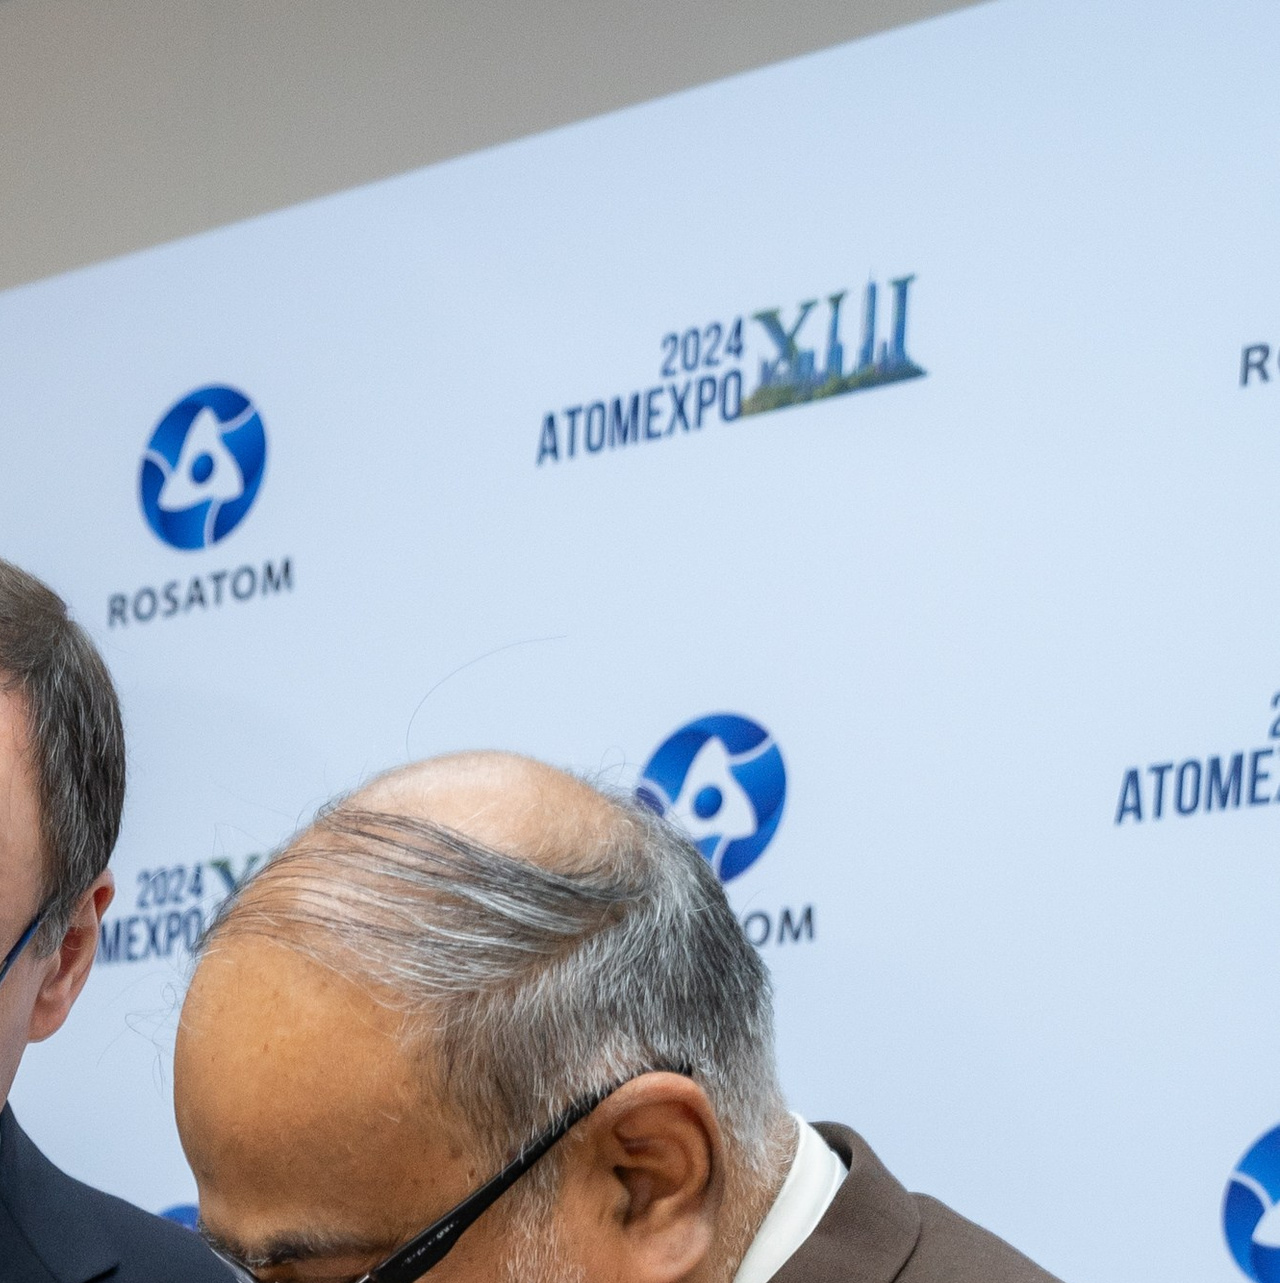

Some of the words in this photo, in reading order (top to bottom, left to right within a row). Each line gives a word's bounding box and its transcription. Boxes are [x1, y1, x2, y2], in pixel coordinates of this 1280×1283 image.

[660, 316, 745, 379] 2024
[536, 369, 744, 467] ATOMEXPO
[107, 557, 294, 628] ROSATOM
[1115, 747, 1280, 825] ATOME
[136, 862, 203, 909] 2024
